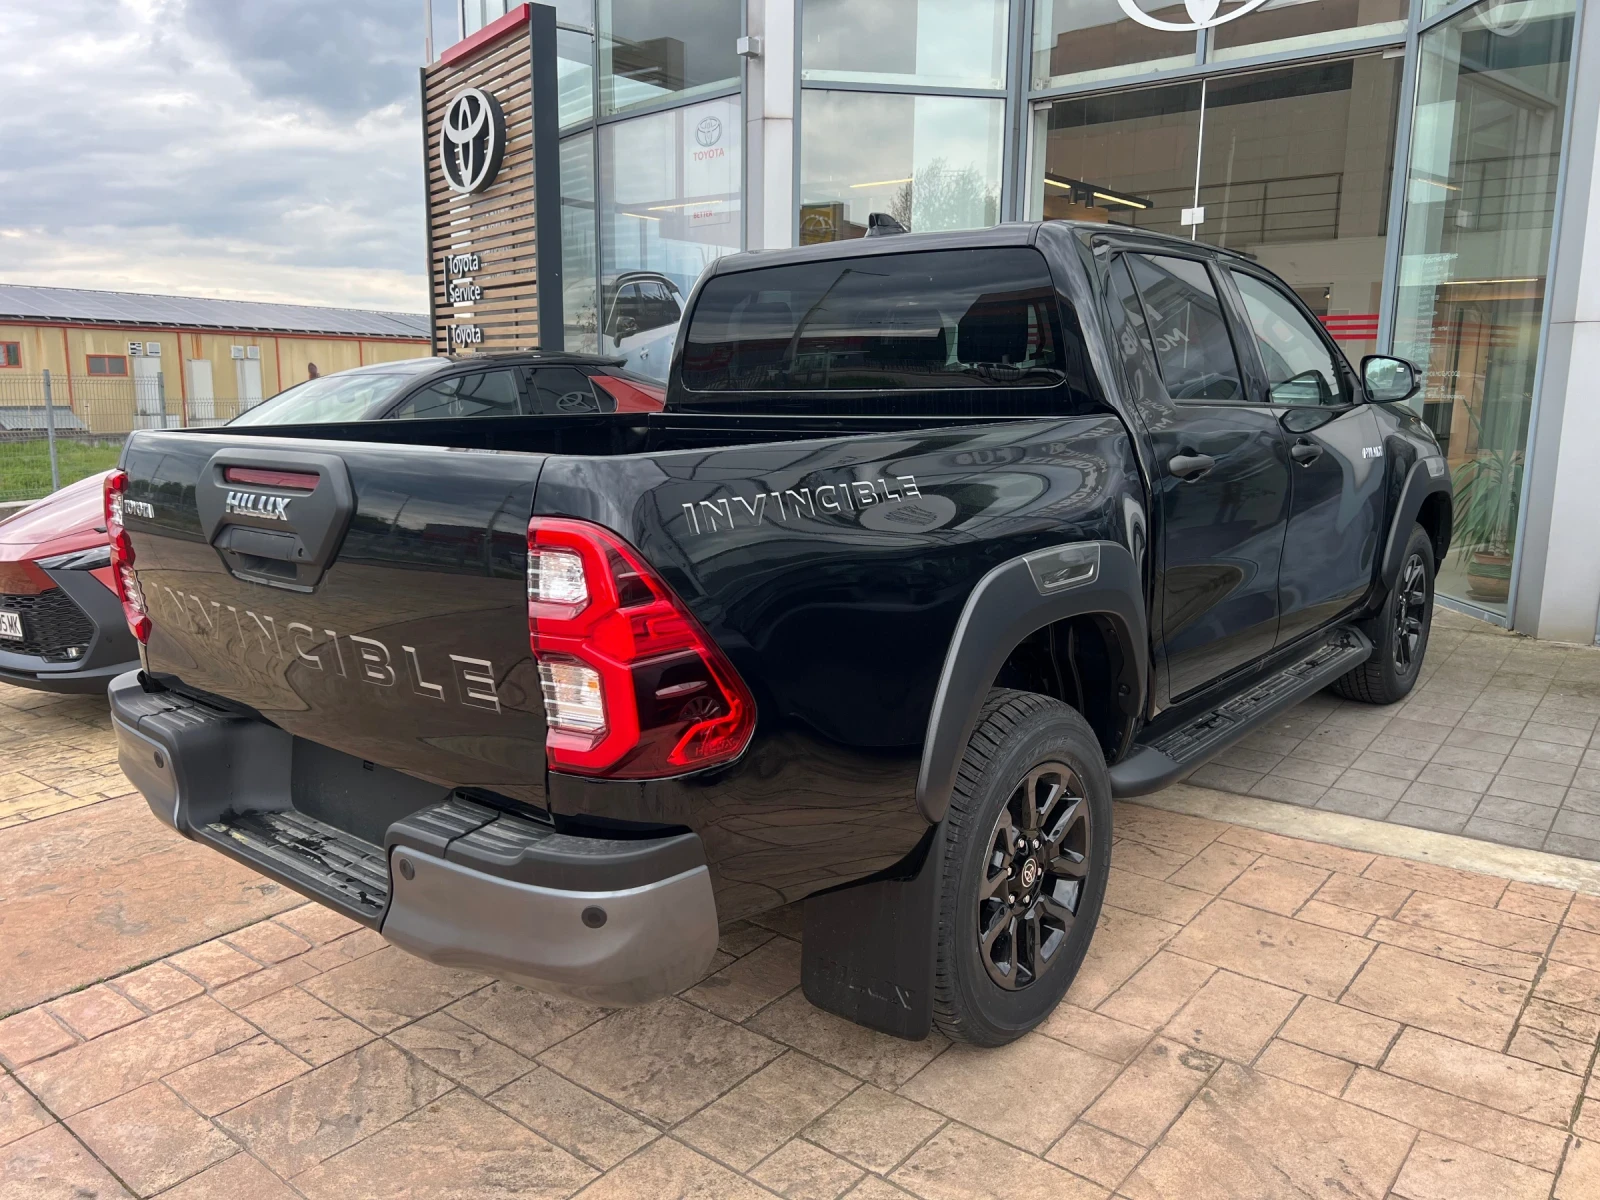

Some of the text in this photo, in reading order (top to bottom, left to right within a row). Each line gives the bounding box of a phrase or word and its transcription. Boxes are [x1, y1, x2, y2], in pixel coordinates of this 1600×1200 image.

[693, 147, 725, 161] TOYOTA
[448, 254, 479, 278] Toyota
[449, 282, 481, 302] Service
[450, 324, 482, 348] Toyota
[124, 499, 155, 519] TOYOTA
[225, 491, 292, 521] HILUX
[682, 475, 923, 536] INVINCIBLE
[151, 582, 502, 715] INVINCIBLE
